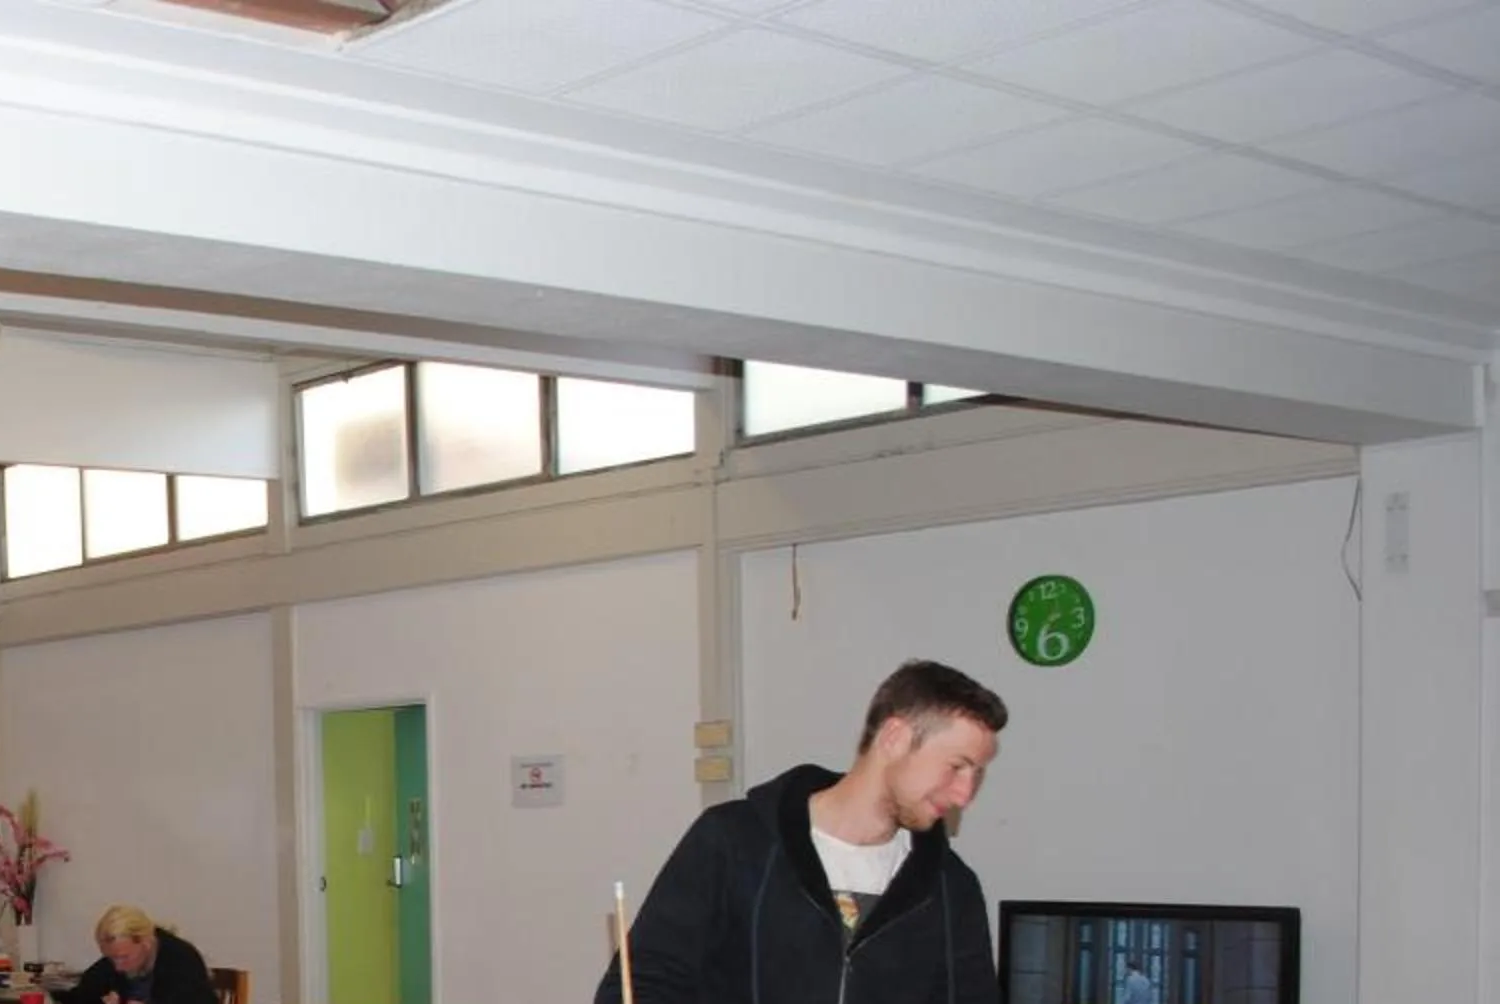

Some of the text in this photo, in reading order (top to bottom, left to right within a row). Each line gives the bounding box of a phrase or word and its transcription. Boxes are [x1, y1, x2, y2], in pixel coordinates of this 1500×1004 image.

[1015, 618, 1028, 640] 9
[1071, 606, 1085, 629] 3
[1037, 613, 1069, 661] 6
